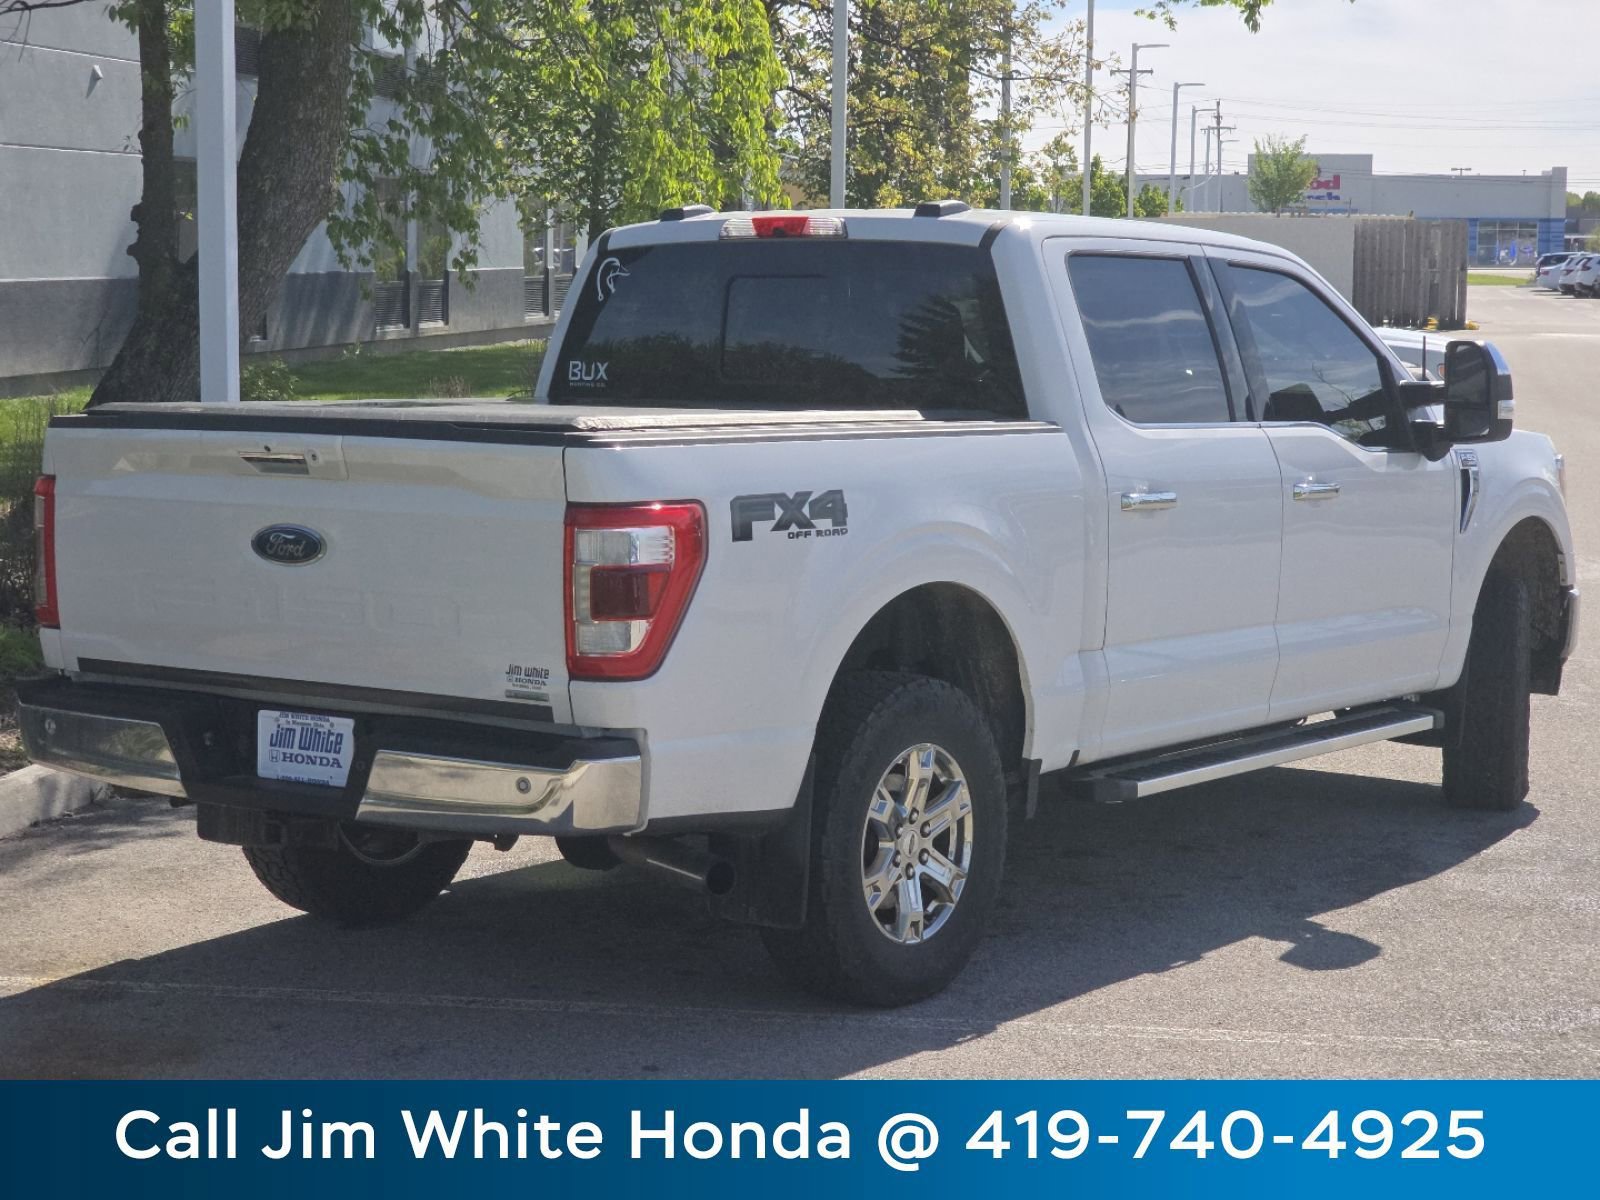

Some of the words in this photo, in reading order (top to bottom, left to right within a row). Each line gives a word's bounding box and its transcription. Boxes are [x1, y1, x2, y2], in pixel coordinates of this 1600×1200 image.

[569, 360, 609, 381] BUX
[730, 489, 848, 542] FX4
[266, 532, 306, 556] Ford
[788, 530, 812, 540] OFF
[816, 528, 848, 537] ROAD
[515, 677, 547, 686] HONDA
[269, 724, 296, 749] Jim
[298, 727, 344, 754] White
[281, 752, 343, 769] HONDA
